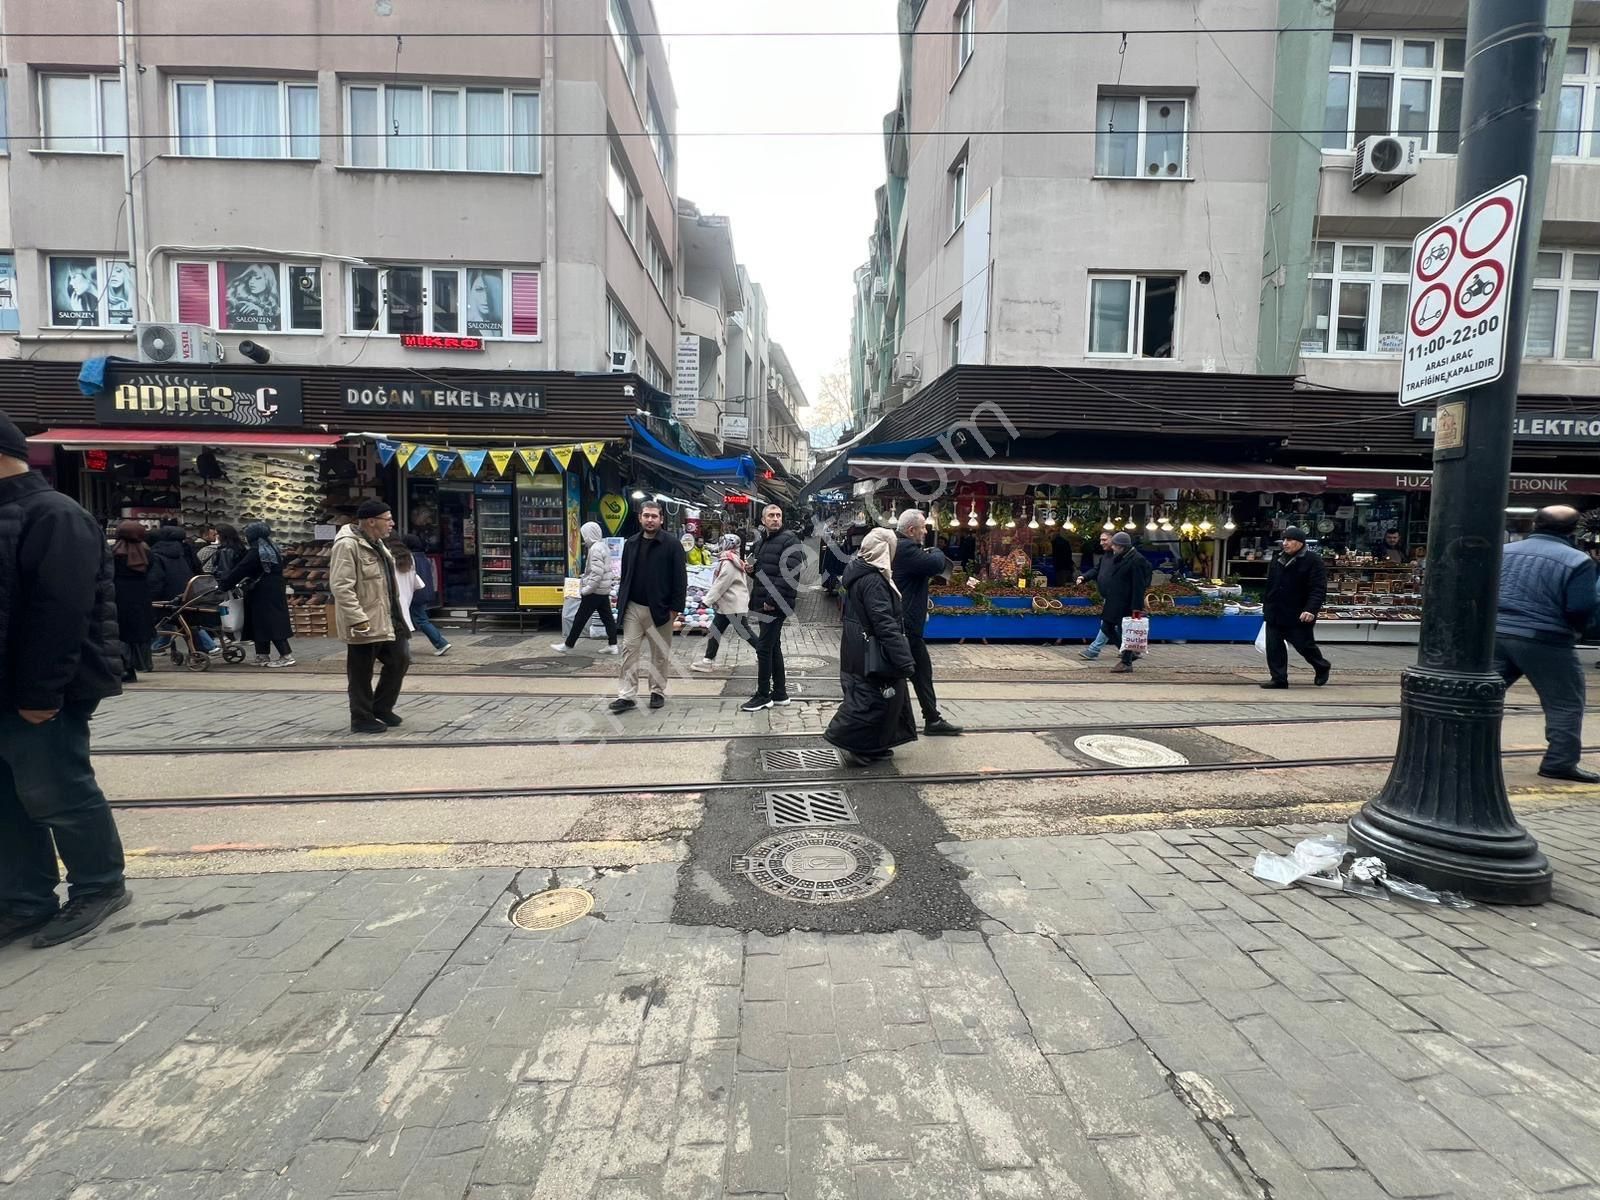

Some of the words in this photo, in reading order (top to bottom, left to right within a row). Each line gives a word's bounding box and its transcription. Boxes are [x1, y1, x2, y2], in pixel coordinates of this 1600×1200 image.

[181, 331, 190, 359] VESTEL
[1408, 315, 1499, 362] 11:00-22:00
[1425, 356, 1449, 372] ARASI
[1450, 348, 1474, 363] ARAÇ
[1406, 372, 1446, 392] TRAFİĞİNE
[1447, 357, 1495, 379] KAPALIDIR
[347, 386, 415, 406] DOĞAN
[420, 389, 484, 407] TEKEL
[1396, 475, 1433, 488] HUZ
